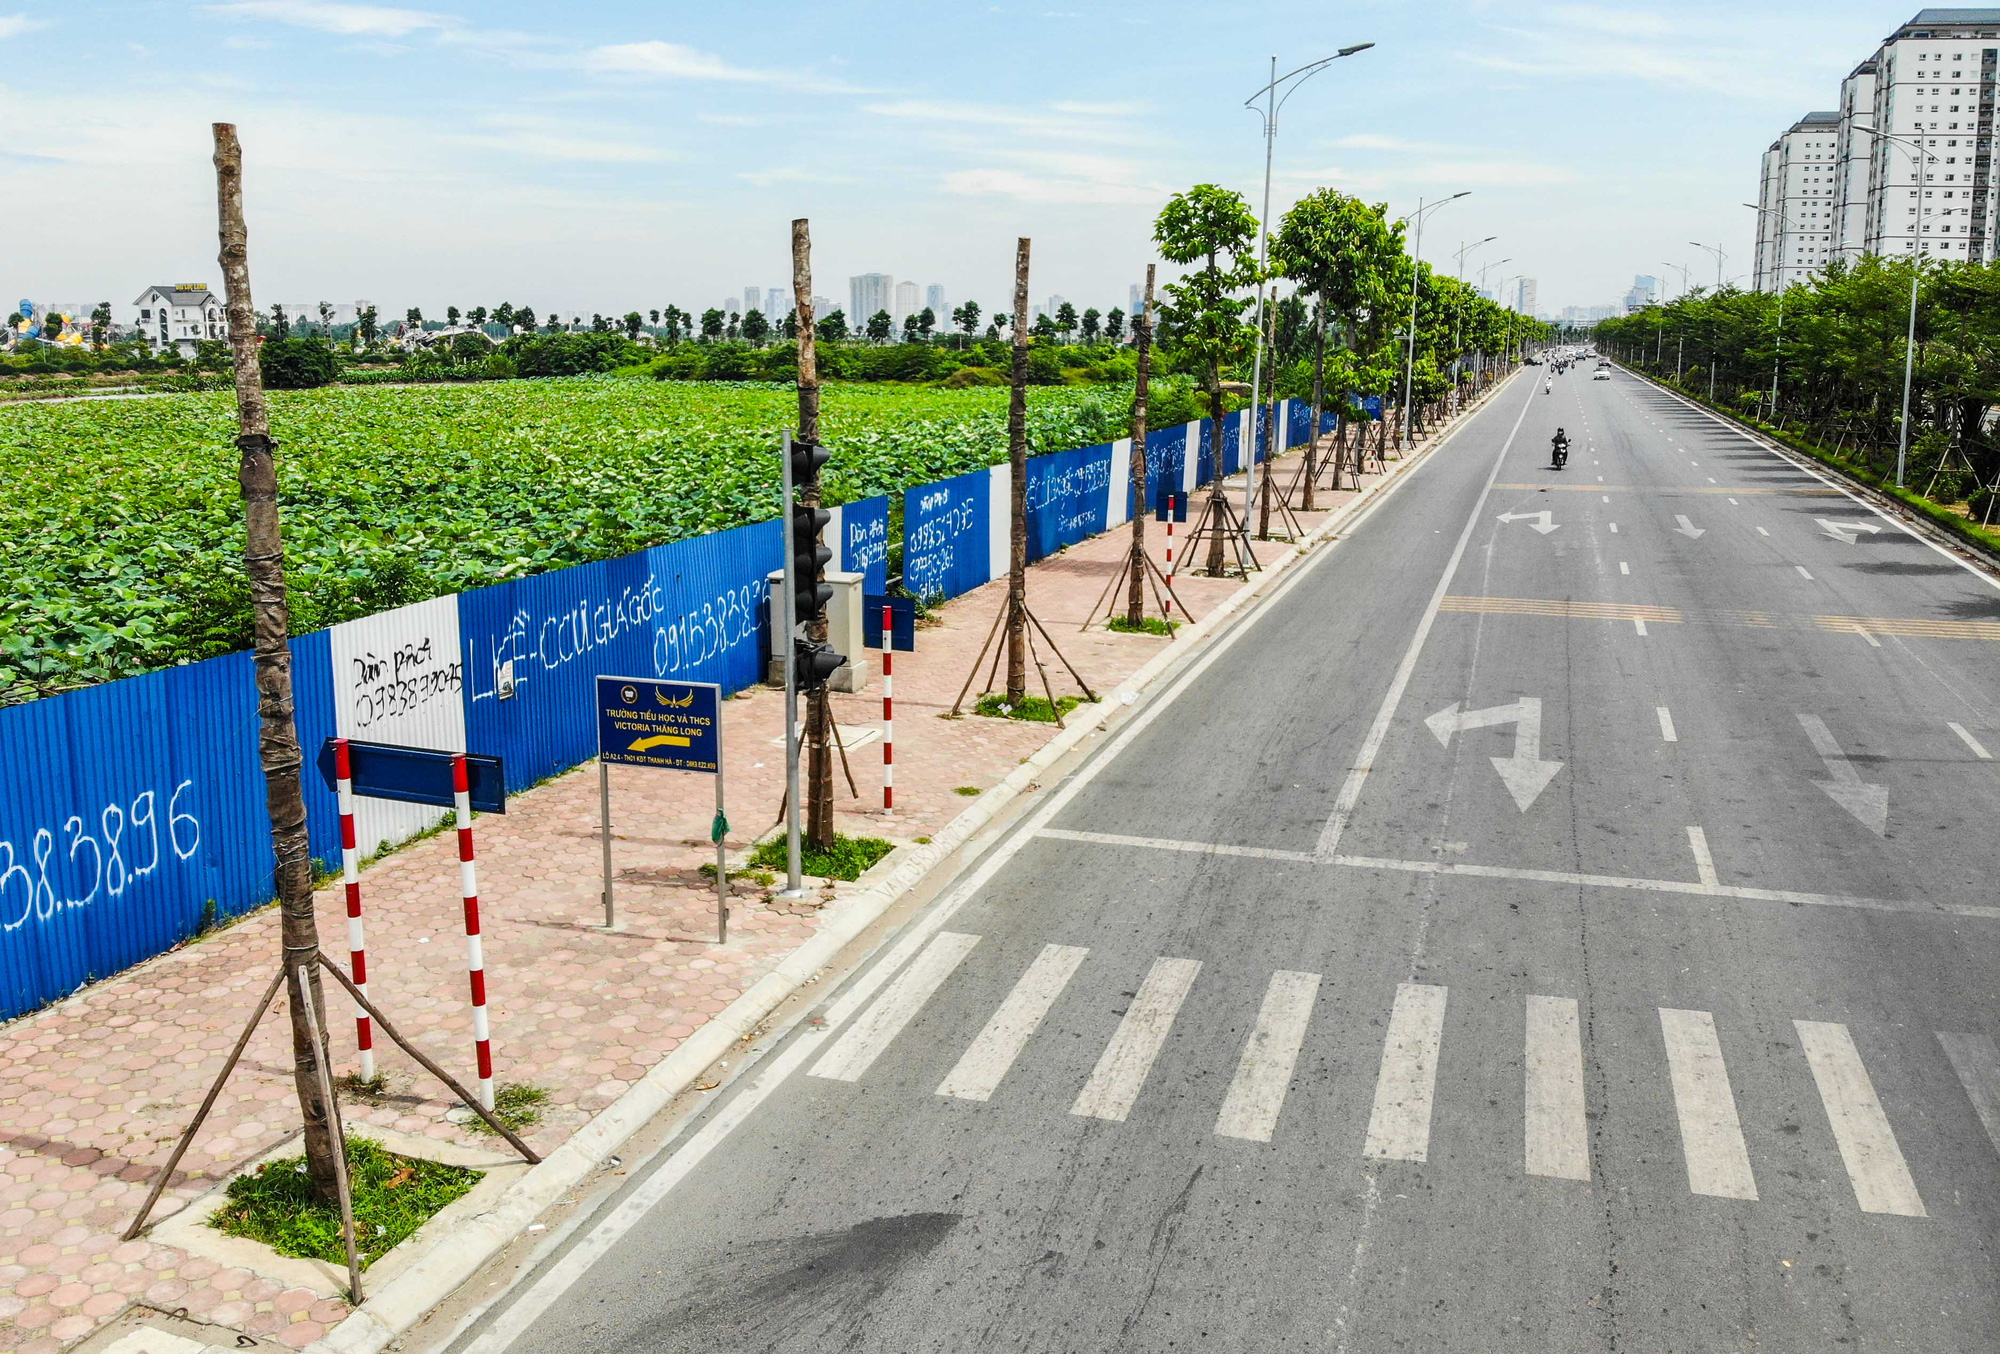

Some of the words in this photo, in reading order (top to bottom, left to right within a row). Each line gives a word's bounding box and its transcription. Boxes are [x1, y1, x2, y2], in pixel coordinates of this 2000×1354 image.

[605, 707, 638, 720] TRƯỜNG
[639, 708, 657, 722] TIỂU
[658, 714, 675, 724] HỌC
[677, 713, 688, 724] VÀ
[689, 716, 711, 726] THCS
[614, 721, 651, 732] VICTORIA
[680, 727, 703, 737] LONG
